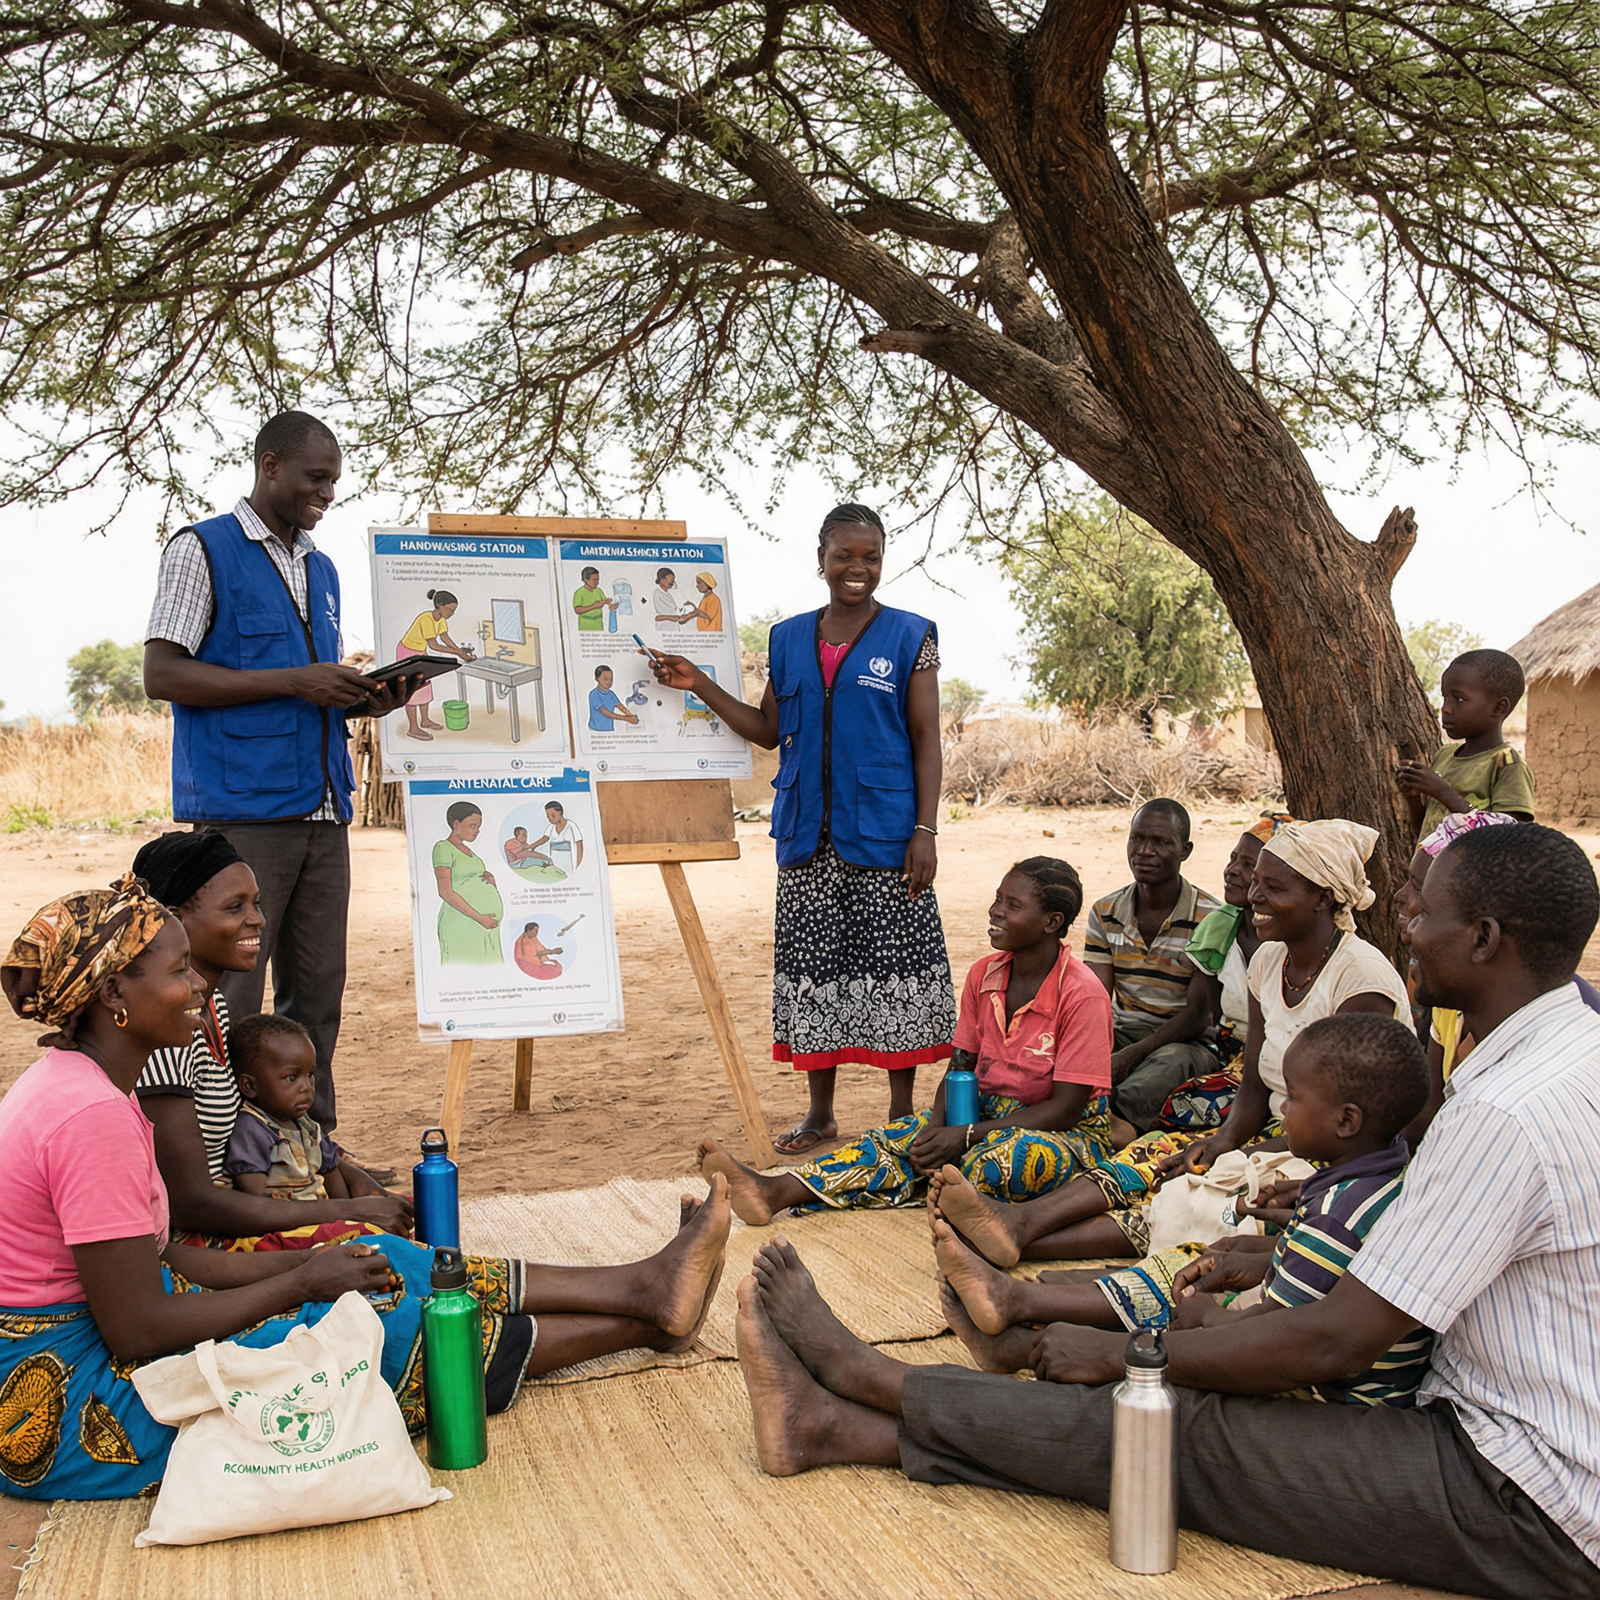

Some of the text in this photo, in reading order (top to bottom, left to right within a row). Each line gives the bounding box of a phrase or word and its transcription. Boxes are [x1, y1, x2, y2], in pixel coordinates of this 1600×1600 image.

[480, 543, 525, 554] STATION
[661, 548, 704, 559] STATION
[448, 776, 552, 789] ANTENATAL CARE
[295, 1456, 335, 1473] HEALTH
